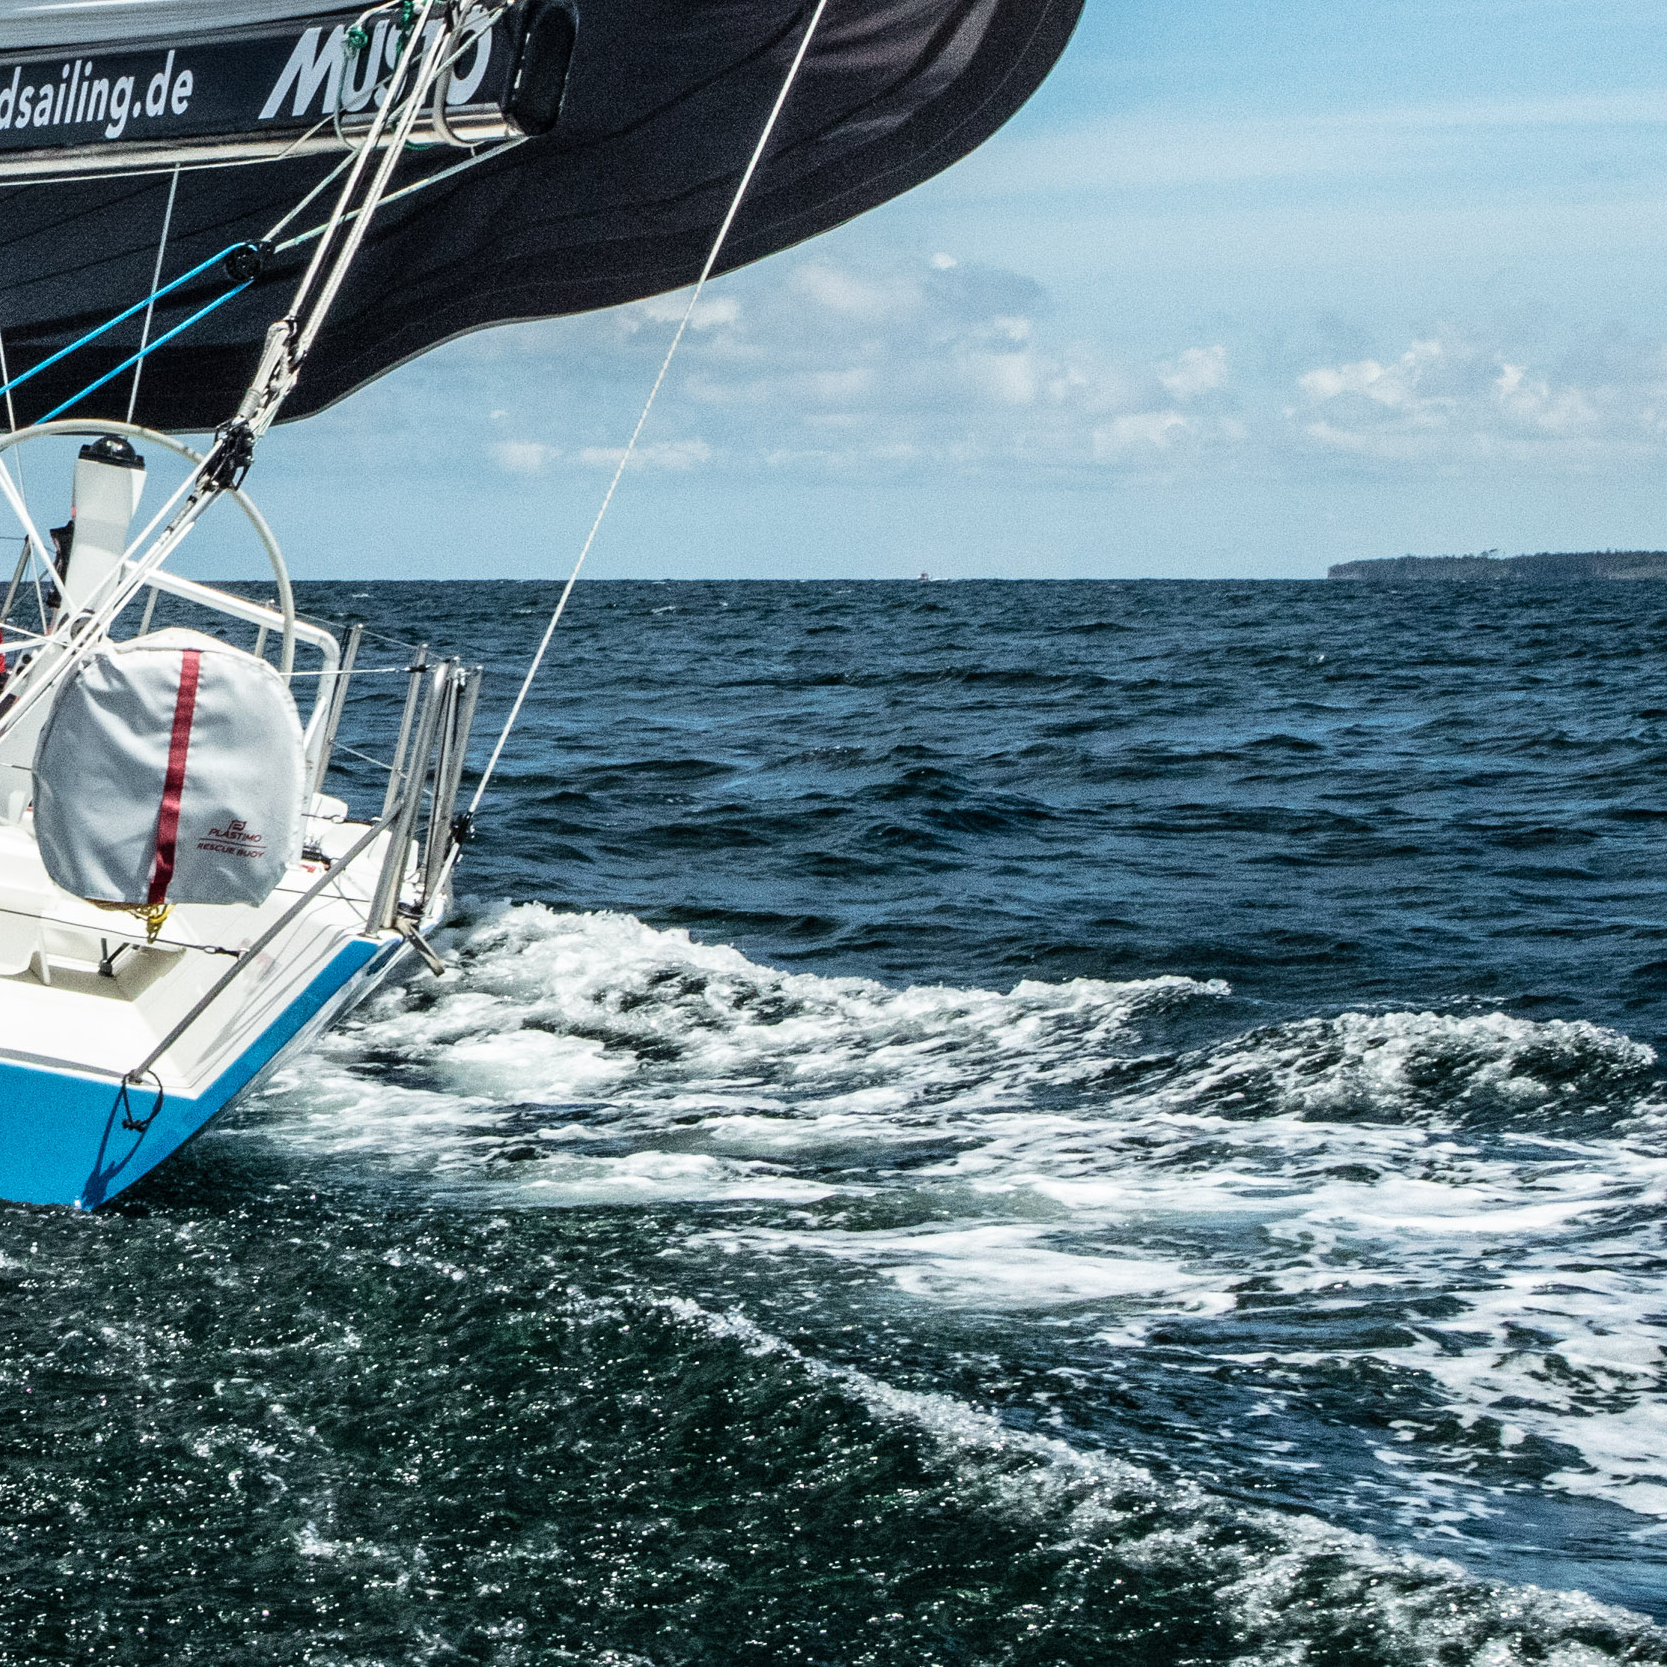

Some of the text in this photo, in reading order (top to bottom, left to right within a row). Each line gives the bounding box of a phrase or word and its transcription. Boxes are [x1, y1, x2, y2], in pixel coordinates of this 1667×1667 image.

[208, 828, 262, 842] PLASTIMO
[196, 842, 265, 858] RESCUE BUOY
